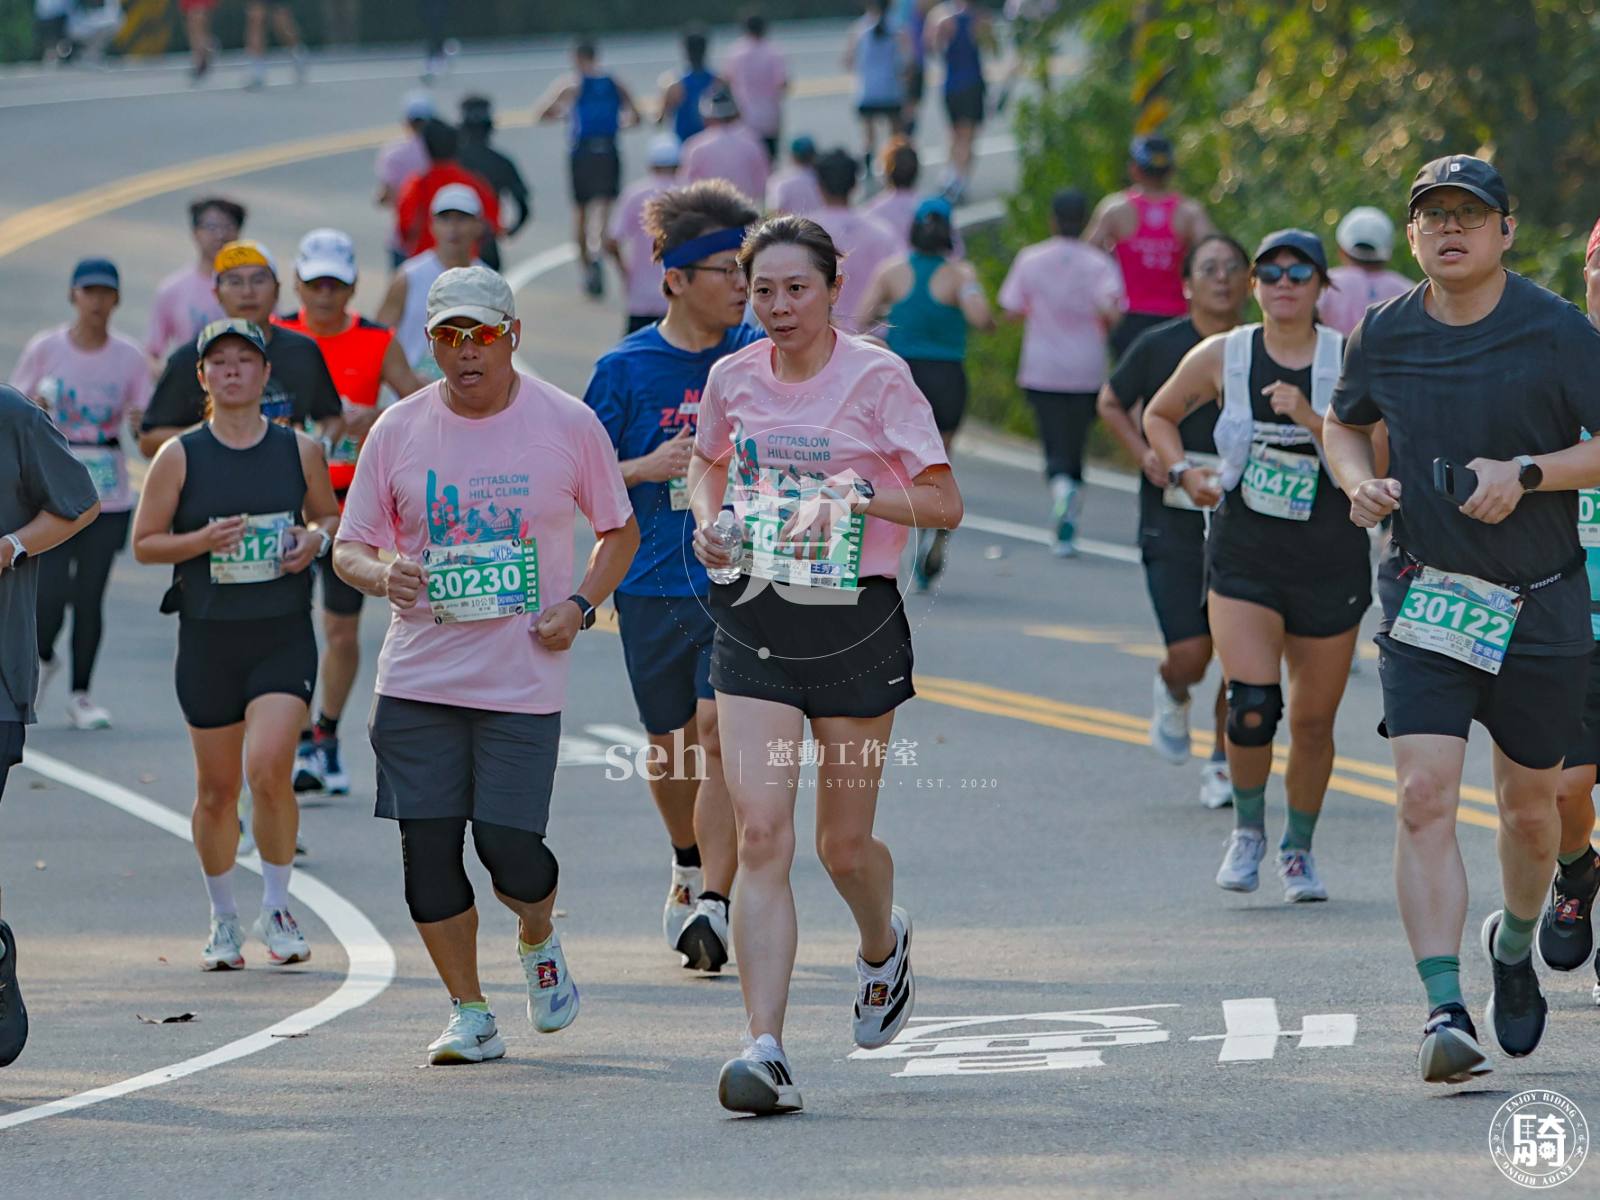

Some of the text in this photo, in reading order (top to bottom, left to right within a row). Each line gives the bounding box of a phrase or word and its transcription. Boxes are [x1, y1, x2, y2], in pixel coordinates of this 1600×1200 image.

[767, 434, 830, 448] CITTASLOW
[768, 449, 831, 462] HILL CLIMB
[469, 474, 529, 487] CITTASLOW
[1243, 464, 1314, 499] 40472
[469, 487, 529, 499] HILL CLIMB
[428, 564, 521, 600] 30230
[1404, 591, 1510, 646] 30122
